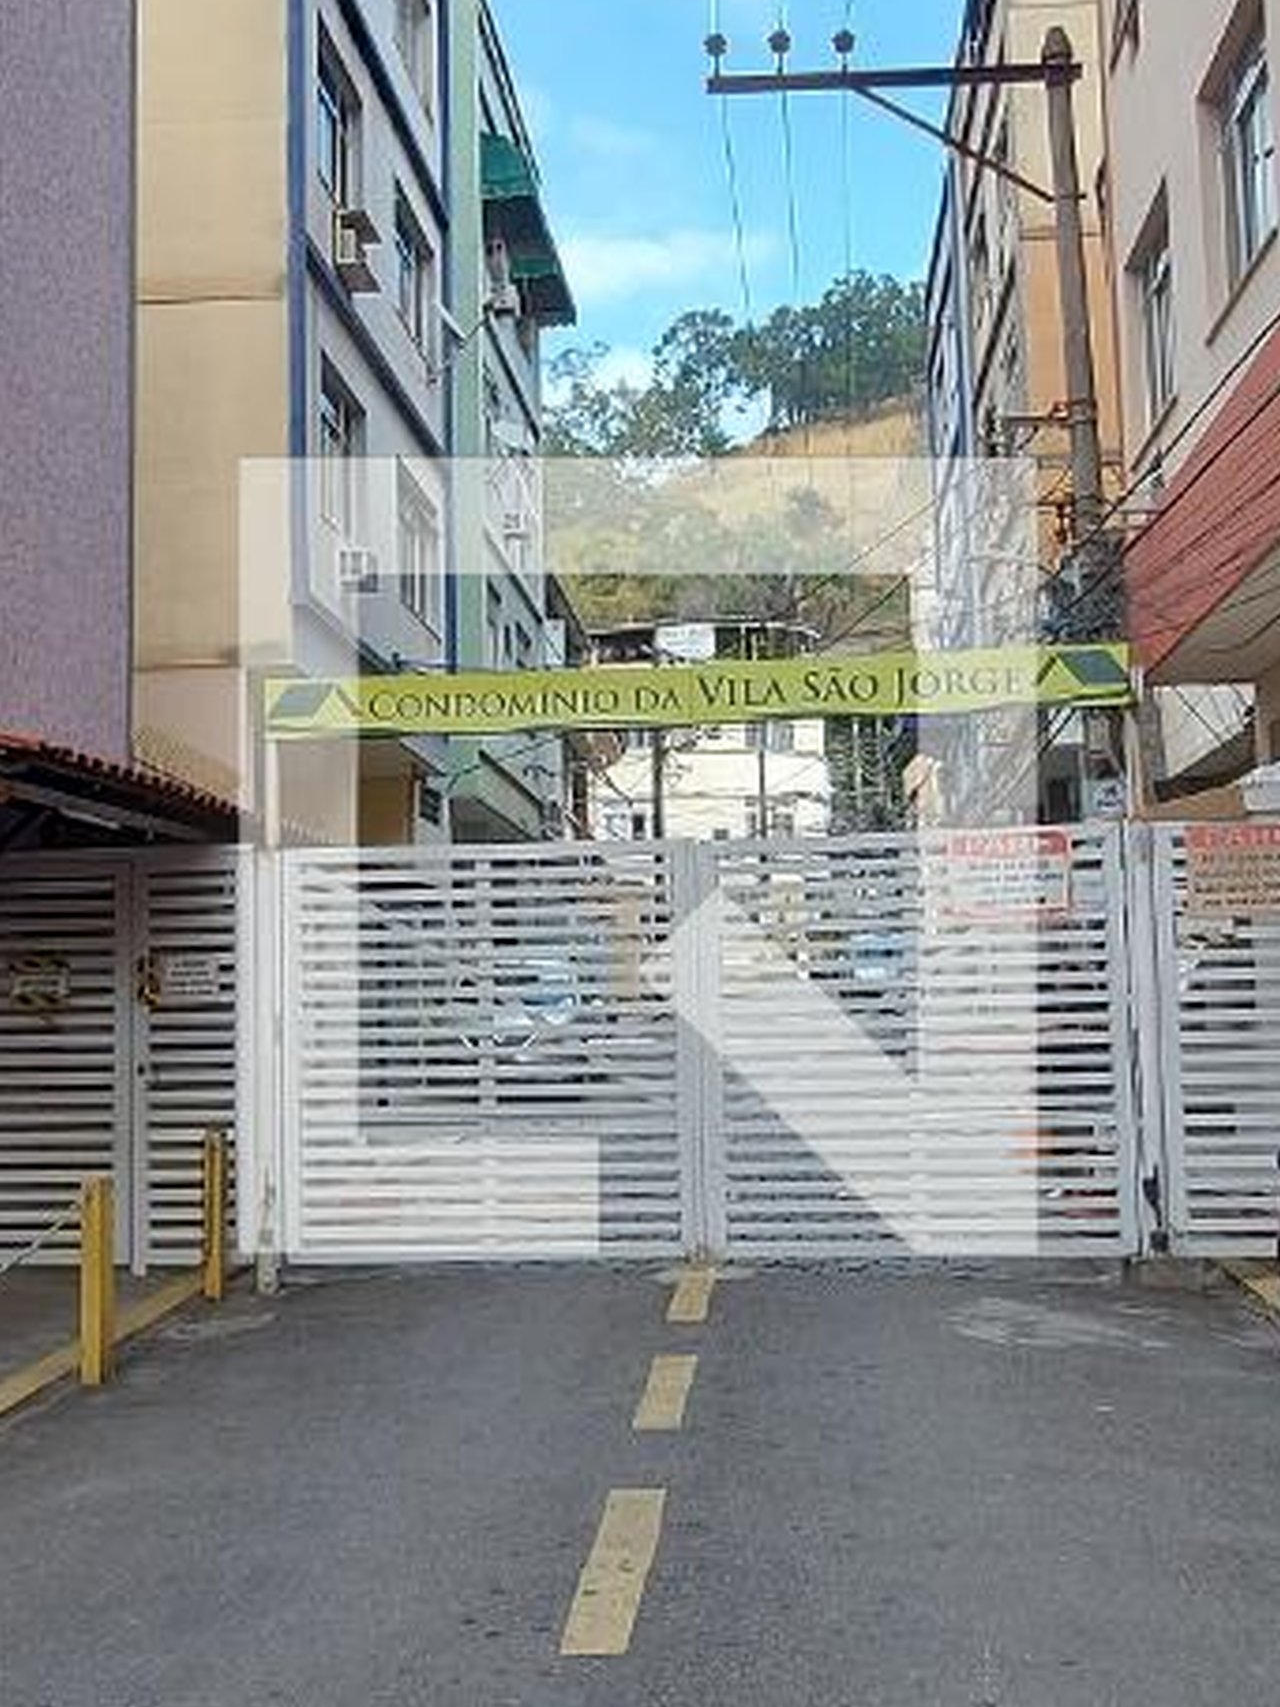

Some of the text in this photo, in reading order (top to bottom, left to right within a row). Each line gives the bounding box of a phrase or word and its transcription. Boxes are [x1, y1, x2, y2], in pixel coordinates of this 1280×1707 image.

[634, 689, 682, 712] DA
[696, 677, 788, 707] VILA
[802, 668, 880, 704] SÃO
[893, 667, 1022, 708] JORGE
